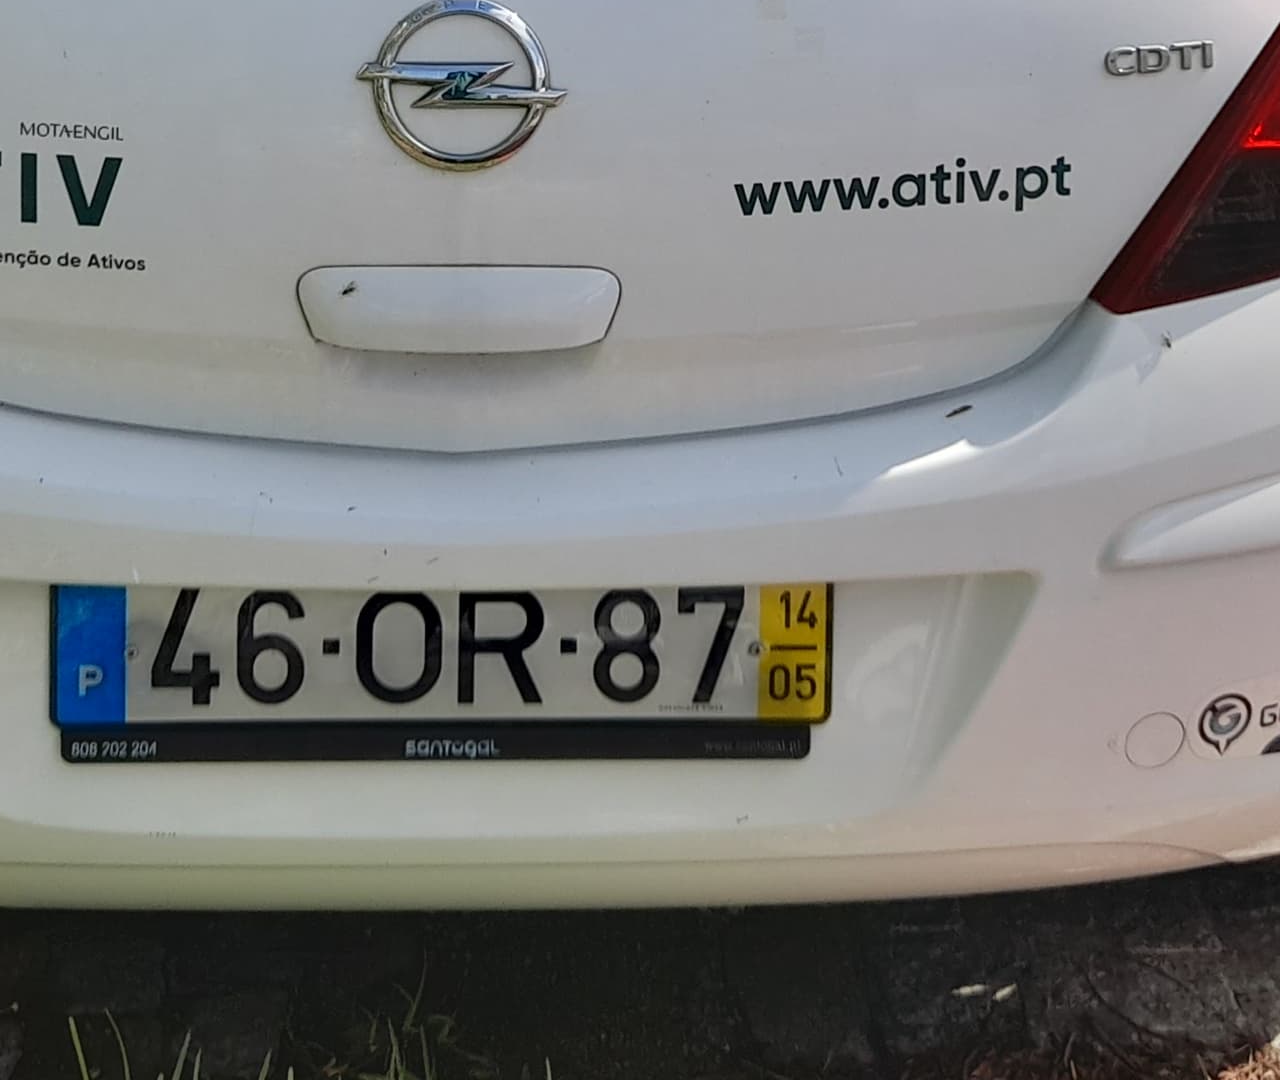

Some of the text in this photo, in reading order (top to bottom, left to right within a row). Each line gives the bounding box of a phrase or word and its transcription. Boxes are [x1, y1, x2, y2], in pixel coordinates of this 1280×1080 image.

[1104, 40, 1213, 76] CDTI
[734, 156, 1071, 216] www.ativ.pt
[57, 252, 81, 268] de
[87, 253, 146, 271] Ativos
[779, 590, 818, 629] 14
[79, 665, 103, 696] P
[769, 664, 817, 701] 05
[71, 740, 98, 759] 808
